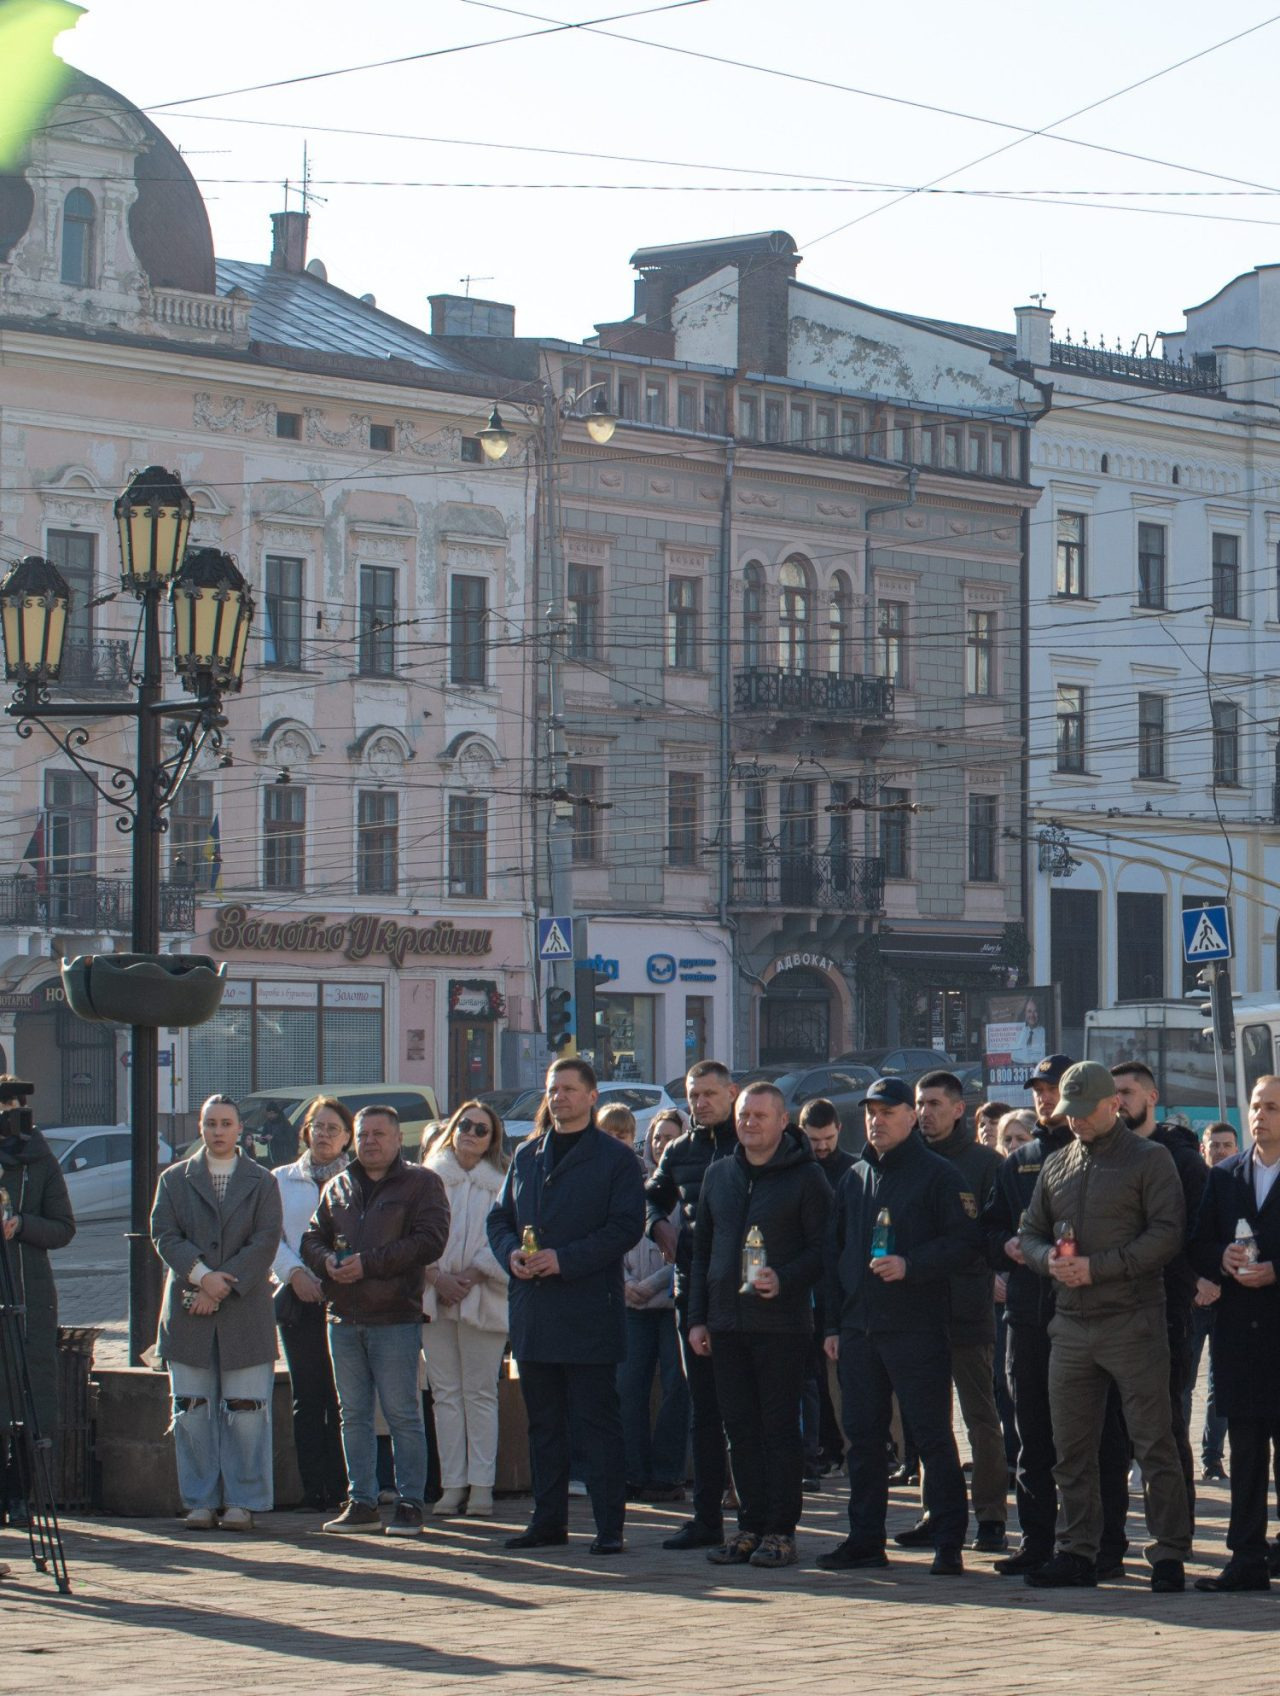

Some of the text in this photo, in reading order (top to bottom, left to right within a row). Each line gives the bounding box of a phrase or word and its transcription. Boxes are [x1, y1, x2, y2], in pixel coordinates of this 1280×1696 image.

[209, 902, 493, 968] Золото України
[776, 953, 835, 973] АДВОКАТ
[334, 987, 369, 1002] Золото
